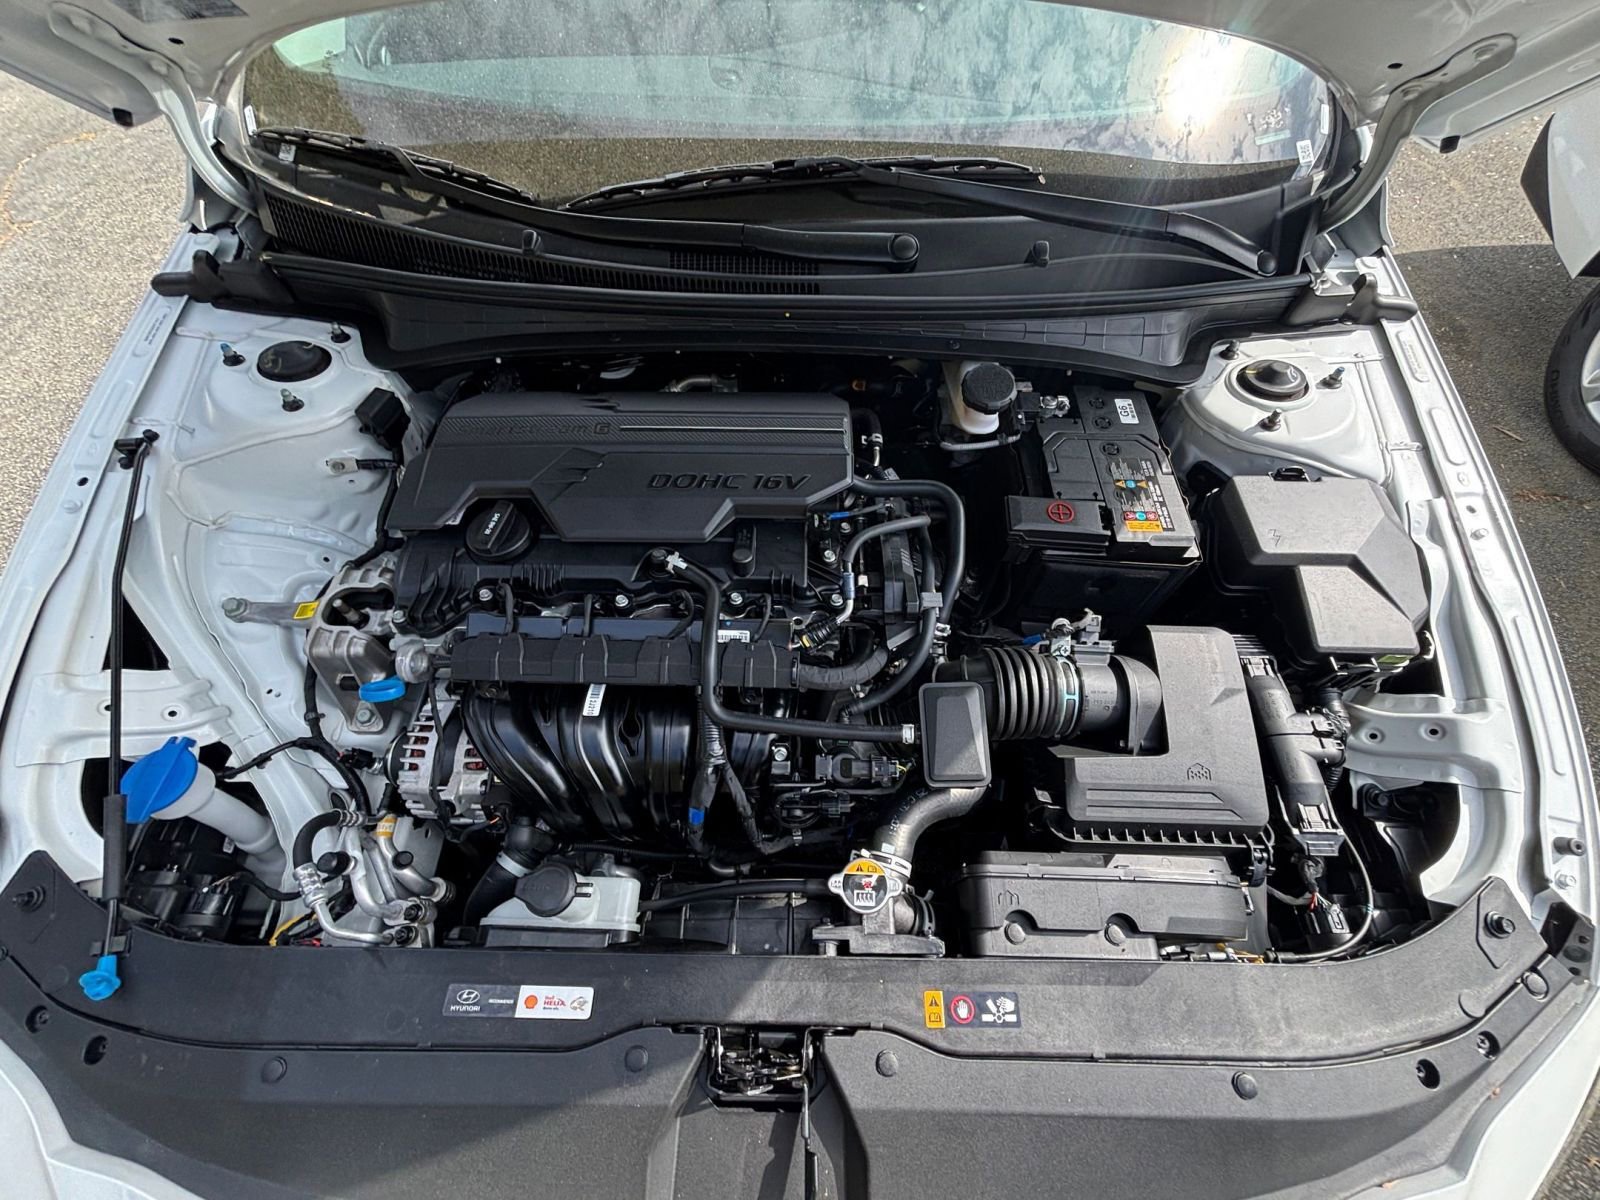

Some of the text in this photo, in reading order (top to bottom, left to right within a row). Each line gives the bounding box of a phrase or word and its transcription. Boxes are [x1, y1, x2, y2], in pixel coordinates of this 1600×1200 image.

[1118, 405, 1130, 417] G6
[648, 473, 812, 490] DOHC 16V
[543, 998, 566, 1006] HELIX
[450, 1004, 481, 1012] HYUNDAI
